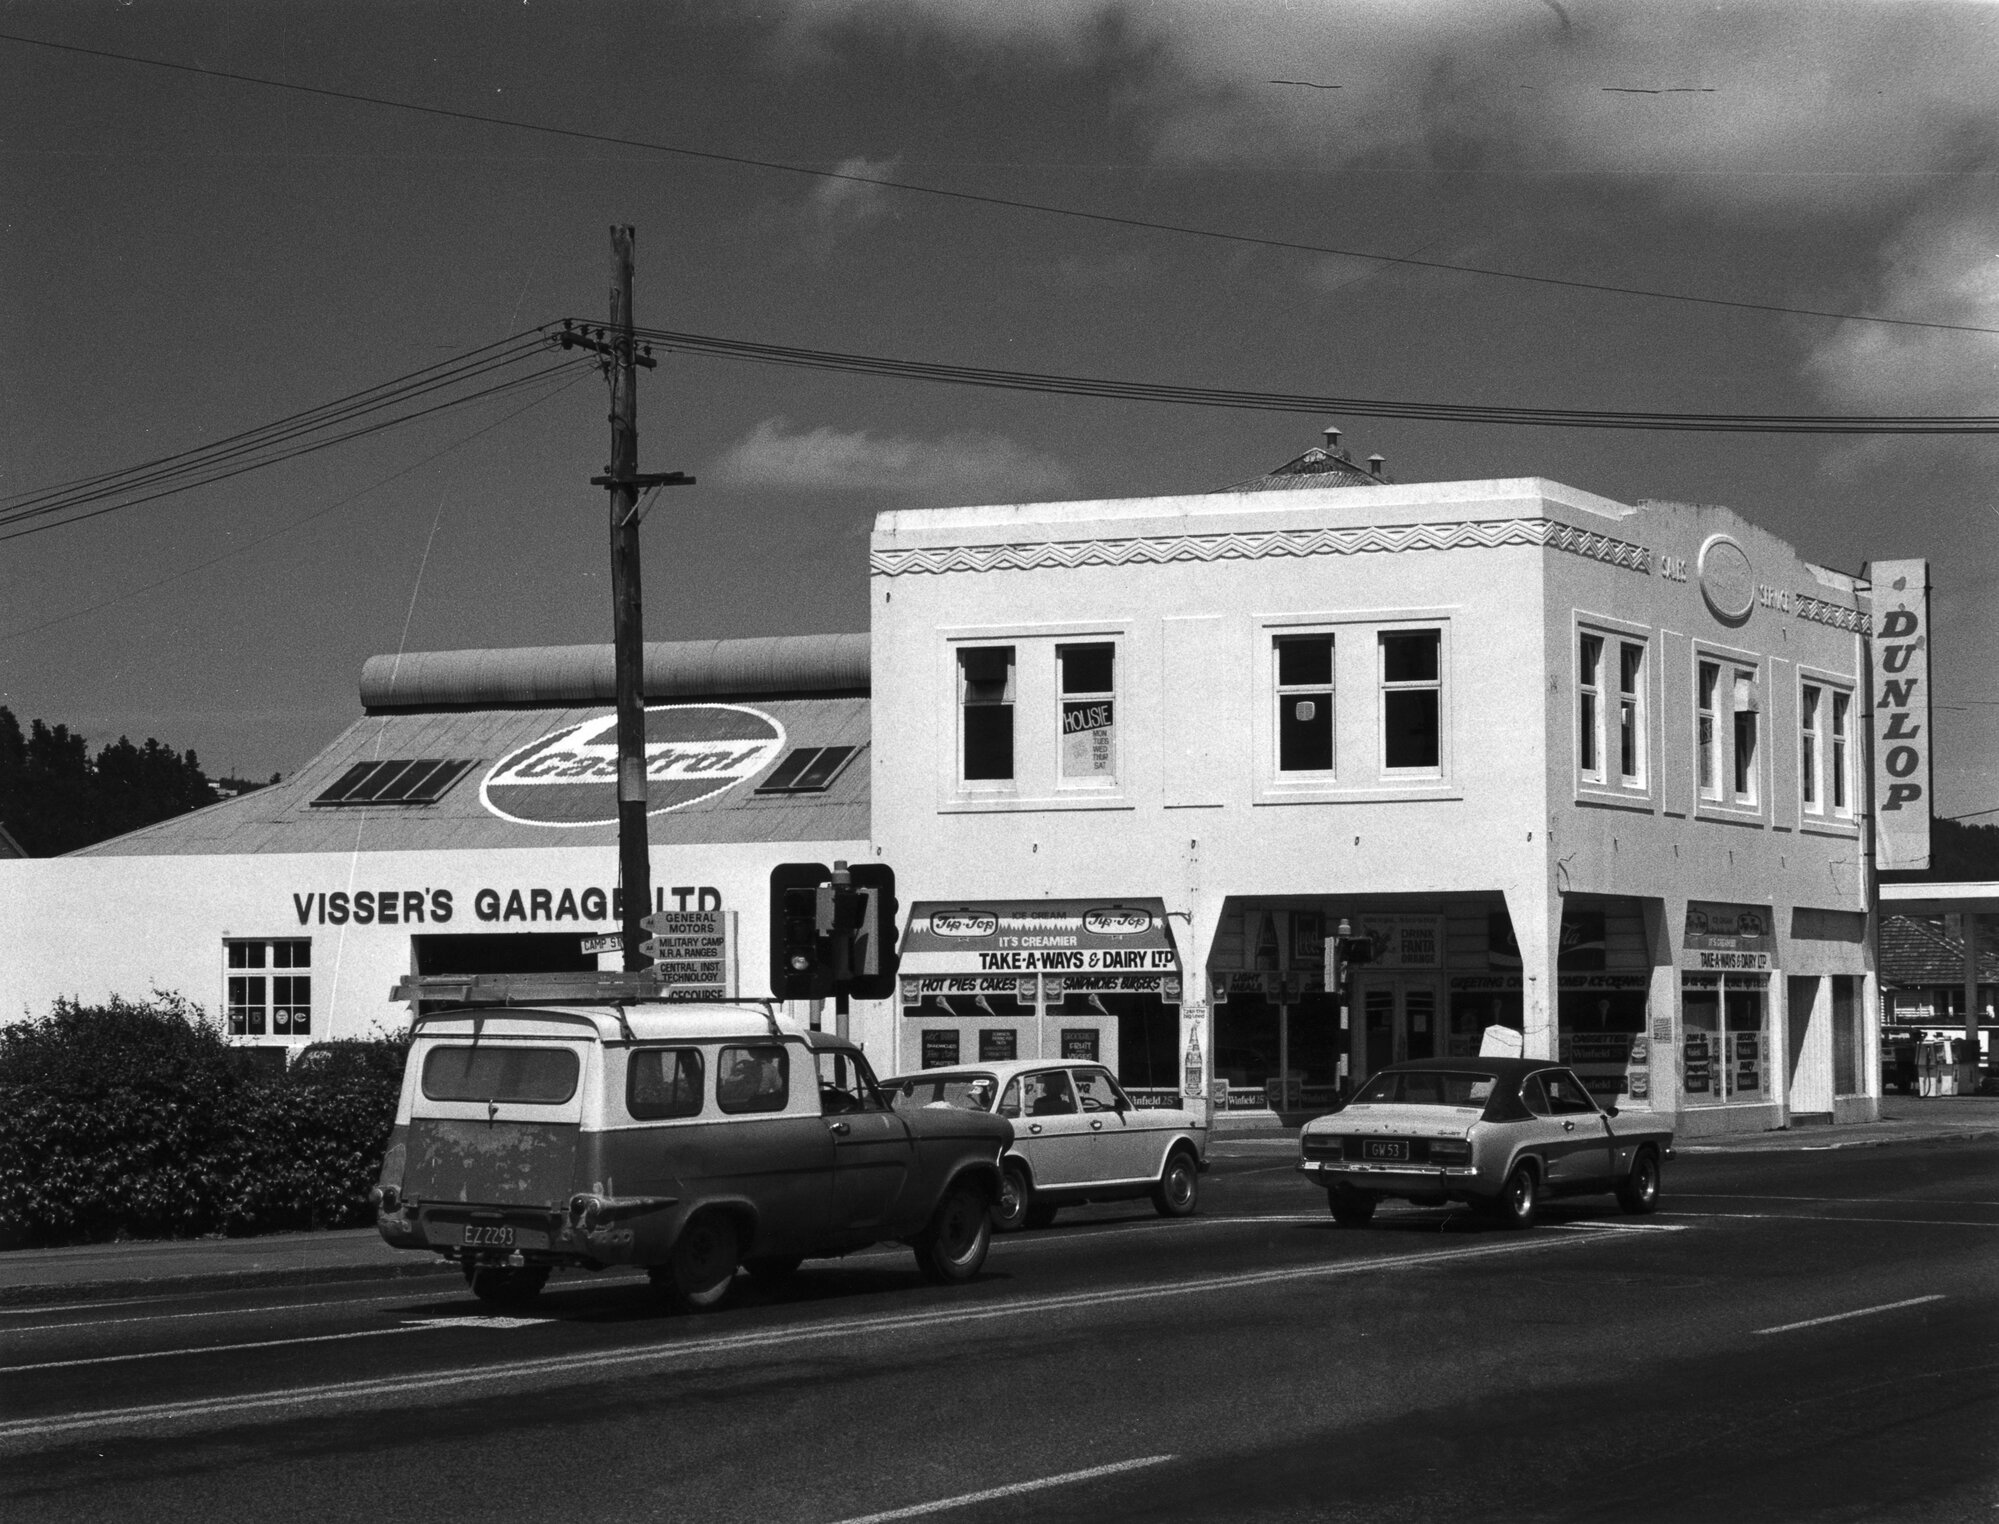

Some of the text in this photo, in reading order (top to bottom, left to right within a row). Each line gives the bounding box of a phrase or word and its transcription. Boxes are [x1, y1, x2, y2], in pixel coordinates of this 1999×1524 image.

[1661, 555, 1687, 583] SALES
[1876, 610, 1923, 812] DUNLOP
[1063, 705, 1111, 732] HOUSIE
[514, 744, 768, 779] Casrol
[293, 888, 454, 925] VISSER'S
[665, 913, 717, 923] GENERAL
[1012, 911, 1066, 920] ICE CREAM
[669, 924, 715, 933] MOTORS
[1401, 929, 1435, 939] DRINK
[584, 938, 607, 951] CAMP
[659, 937, 725, 947] MILITARY CAMP
[999, 935, 1077, 948] IT'S CREAMIER
[1401, 940, 1436, 953] FANTA
[684, 948, 718, 958] RANGES
[1088, 951, 1101, 969] &
[1102, 950, 1147, 968] DAIRY
[1401, 954, 1435, 964] ORANGE
[660, 963, 697, 972] CENTRAL
[1741, 954, 1756, 968] DAIRY
[662, 973, 718, 982] TECHNOLOGY
[1450, 976, 1504, 990] GREETING
[920, 980, 945, 993] HOT
[948, 979, 977, 993] PIES
[979, 979, 1017, 992] CAKES
[1062, 977, 1118, 992] SANDWICHES
[1120, 977, 1161, 992] BURGERS
[669, 990, 723, 1000] CECOURSE
[1068, 1041, 1092, 1050] FRUIT
[1228, 1096, 1256, 1106] Winfield
